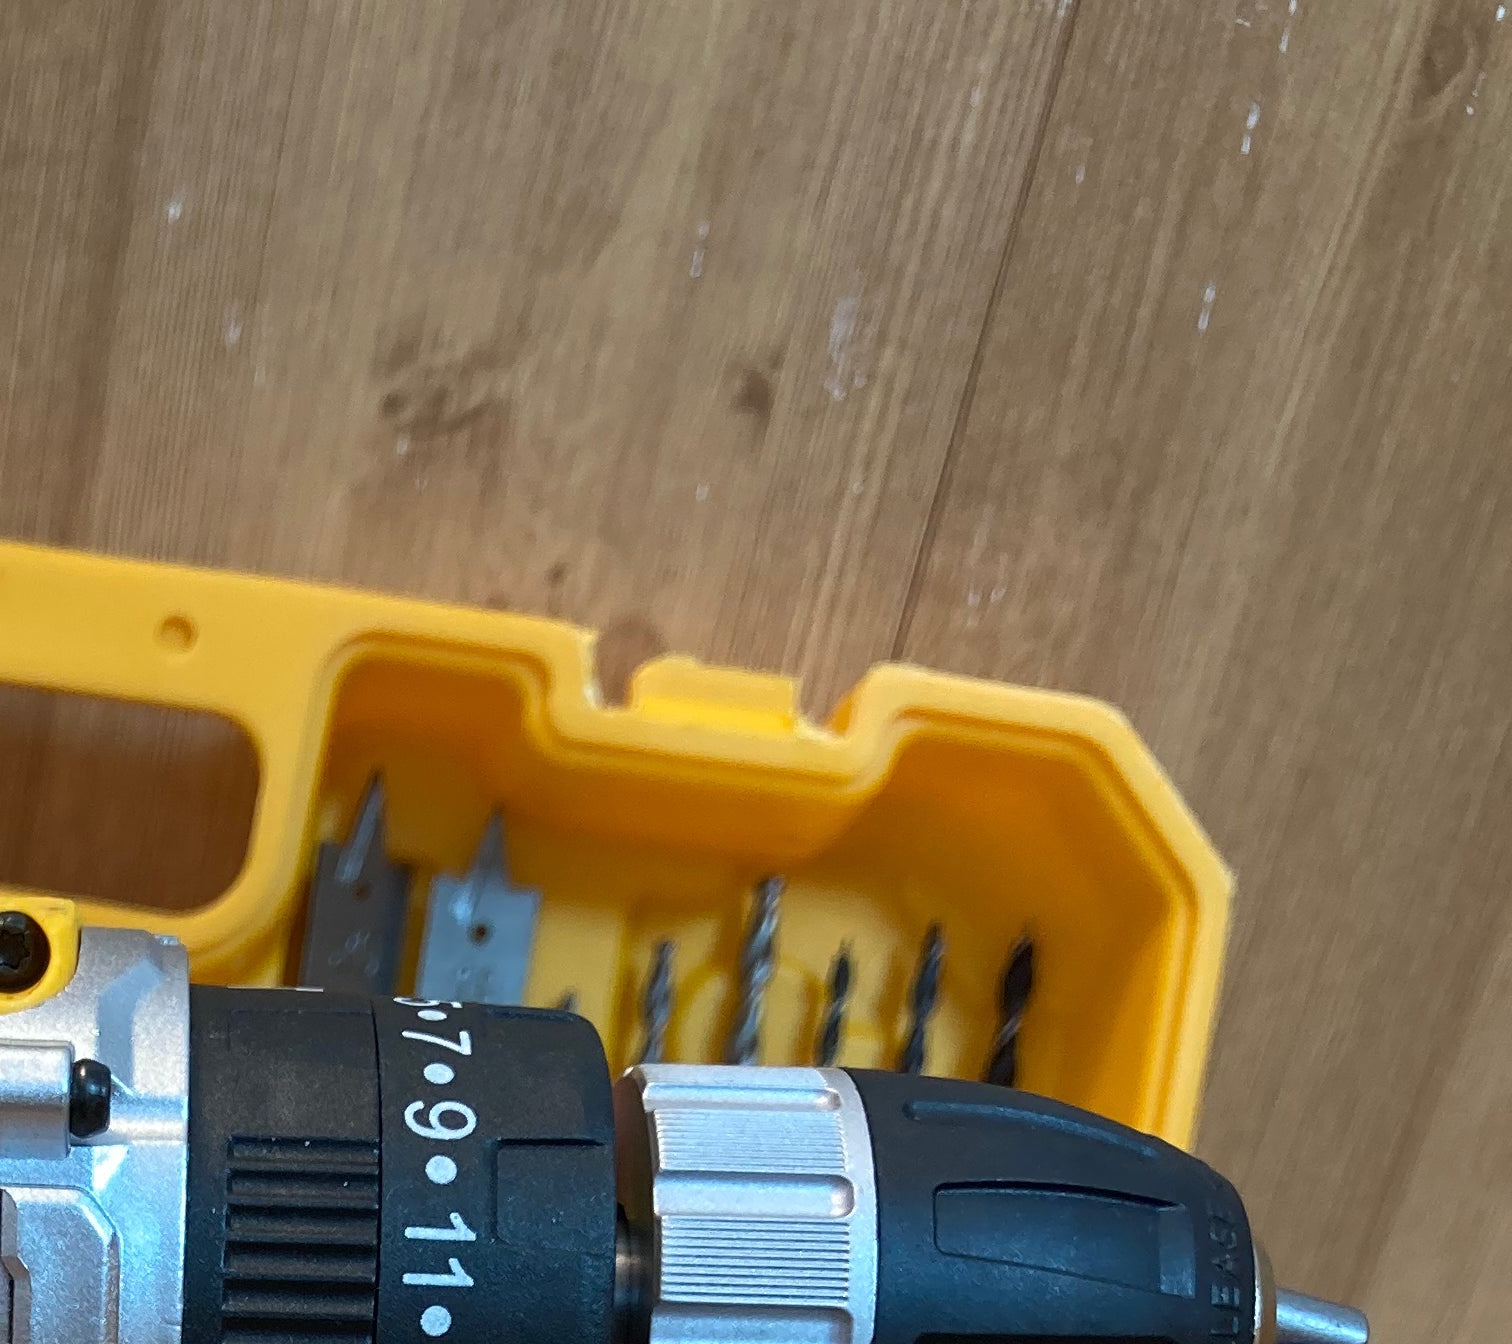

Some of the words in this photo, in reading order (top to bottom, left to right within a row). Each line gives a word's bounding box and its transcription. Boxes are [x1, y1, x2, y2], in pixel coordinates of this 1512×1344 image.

[401, 1030, 472, 1056] 7
[404, 1100, 477, 1141] 9
[402, 1211, 477, 1287] 11
